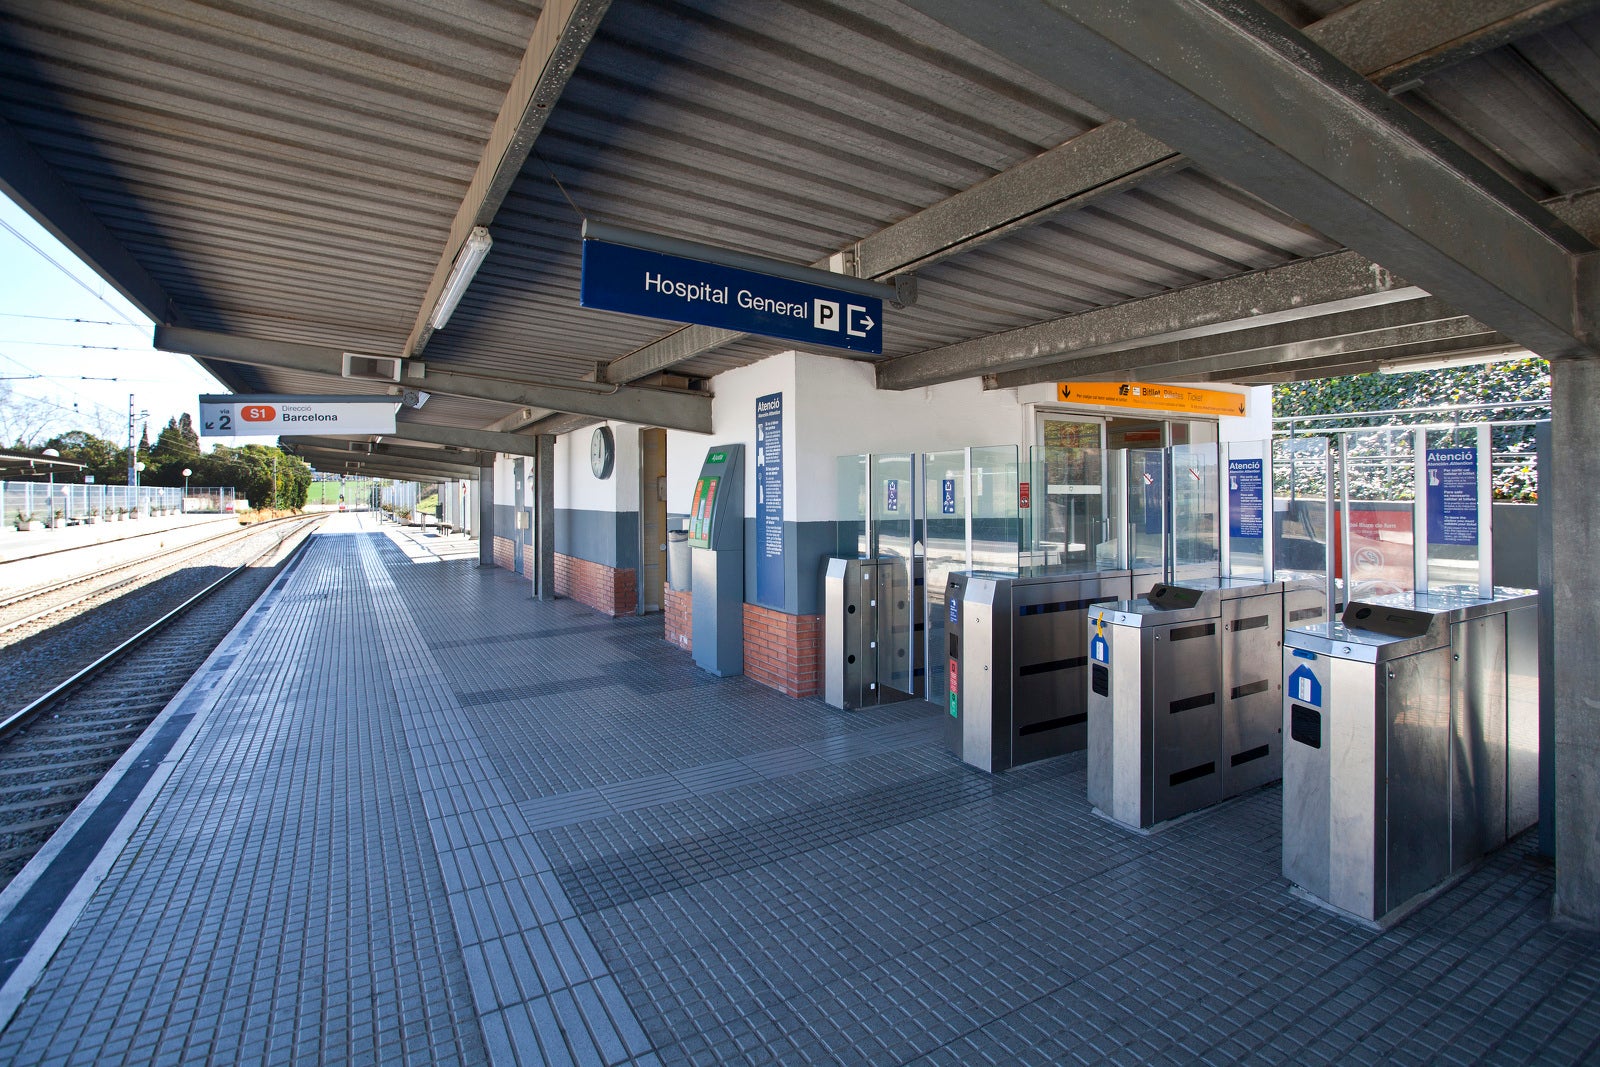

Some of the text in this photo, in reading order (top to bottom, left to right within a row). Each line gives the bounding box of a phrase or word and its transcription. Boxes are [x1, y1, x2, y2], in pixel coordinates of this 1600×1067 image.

[645, 271, 834, 325] Hospital General P
[1142, 387, 1161, 398] Bitllet
[757, 398, 780, 413] Atenció
[249, 409, 267, 419] S1
[282, 413, 338, 422] Barcelona
[219, 415, 232, 430] 2
[1427, 451, 1473, 462] Atenció
[1229, 462, 1260, 470] Atenció
